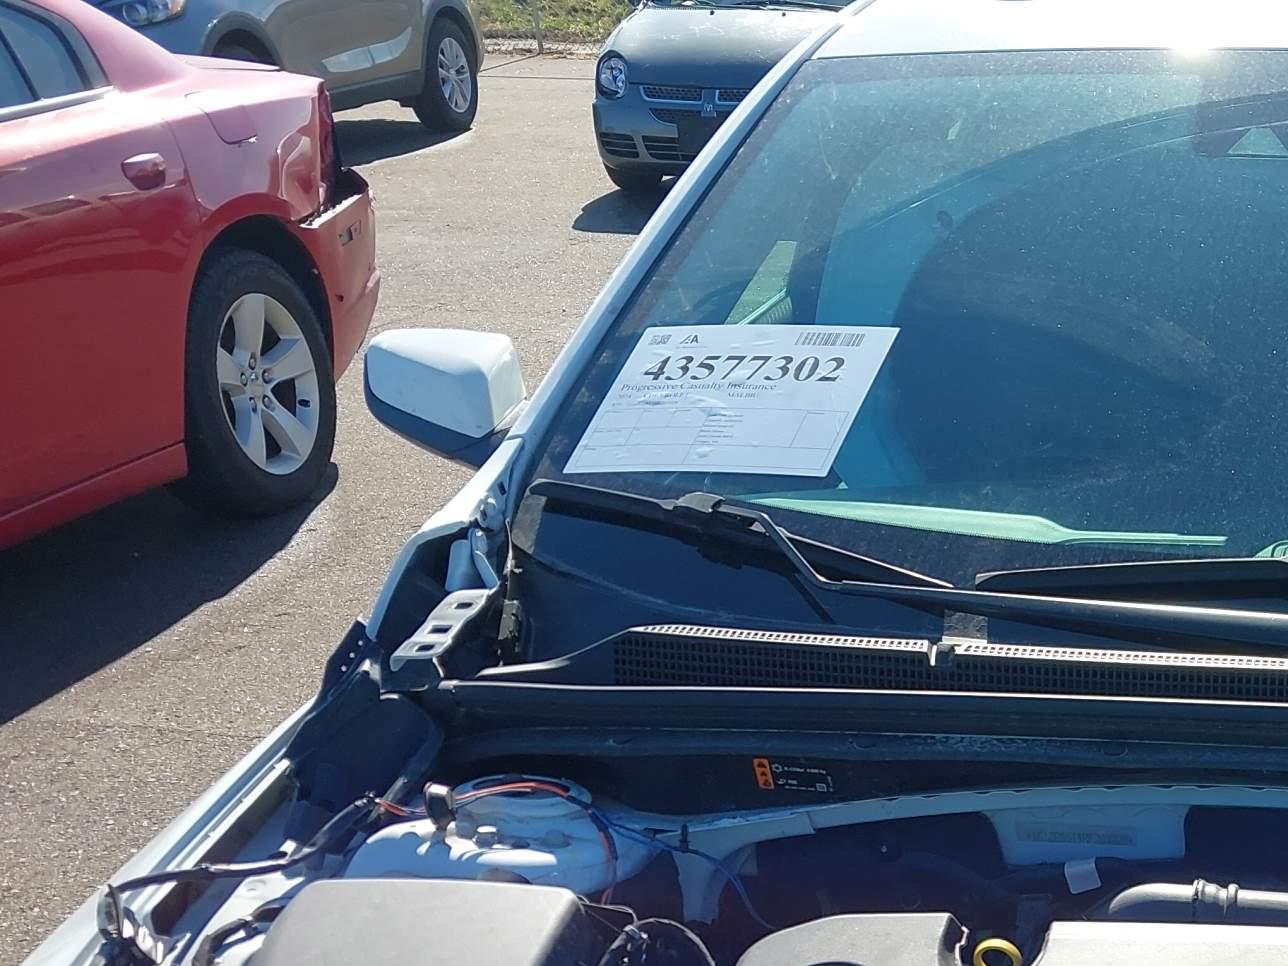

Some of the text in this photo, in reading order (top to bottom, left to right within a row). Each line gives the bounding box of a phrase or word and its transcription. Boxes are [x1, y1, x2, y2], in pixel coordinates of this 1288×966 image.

[643, 355, 846, 383] 43577302
[621, 382, 777, 392] Progressive Casualty Insurance
